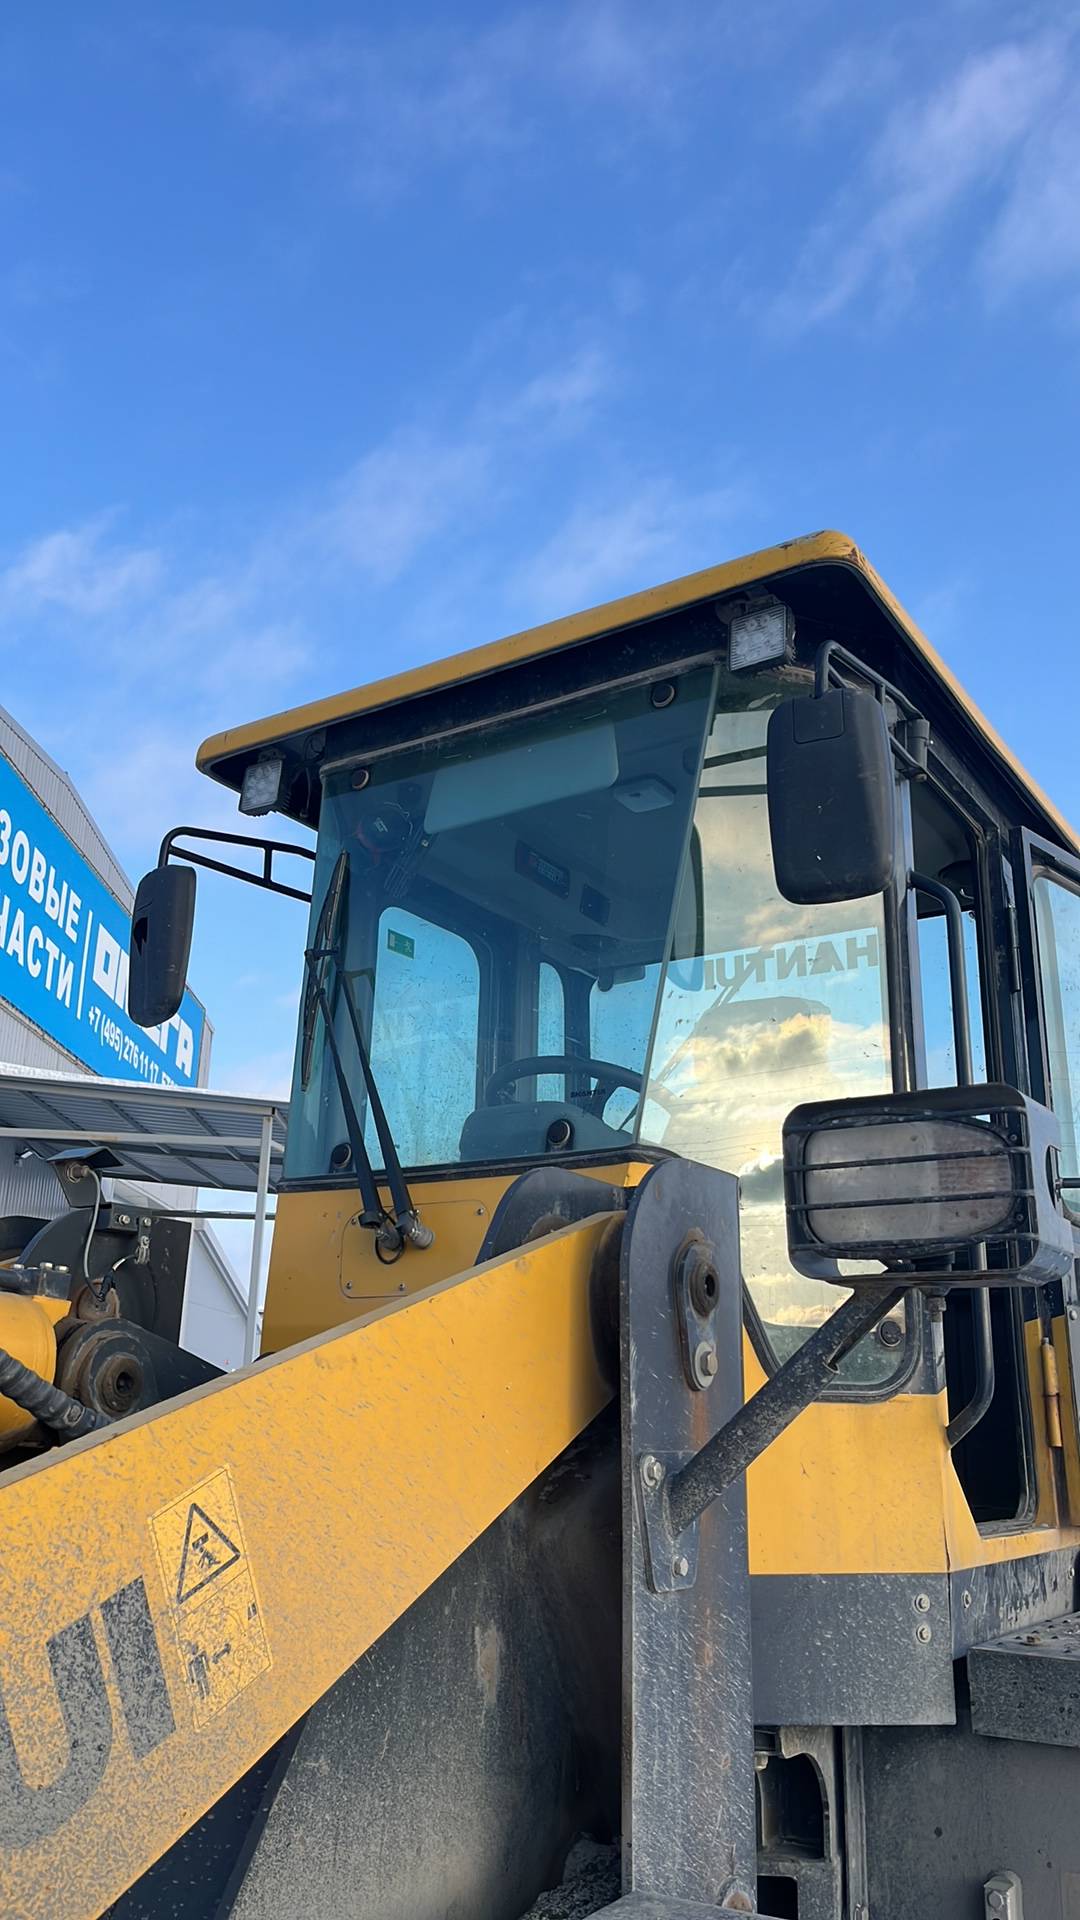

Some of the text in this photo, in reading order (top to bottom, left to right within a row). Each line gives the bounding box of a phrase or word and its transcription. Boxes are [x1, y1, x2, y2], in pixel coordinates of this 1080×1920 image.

[0, 809, 82, 944] ЗОВЫЕ
[88, 1006, 102, 1033] +7
[101, 1014, 123, 1061] (495)
[122, 1036, 140, 1069] 276
[92, 922, 194, 1078] ОГА
